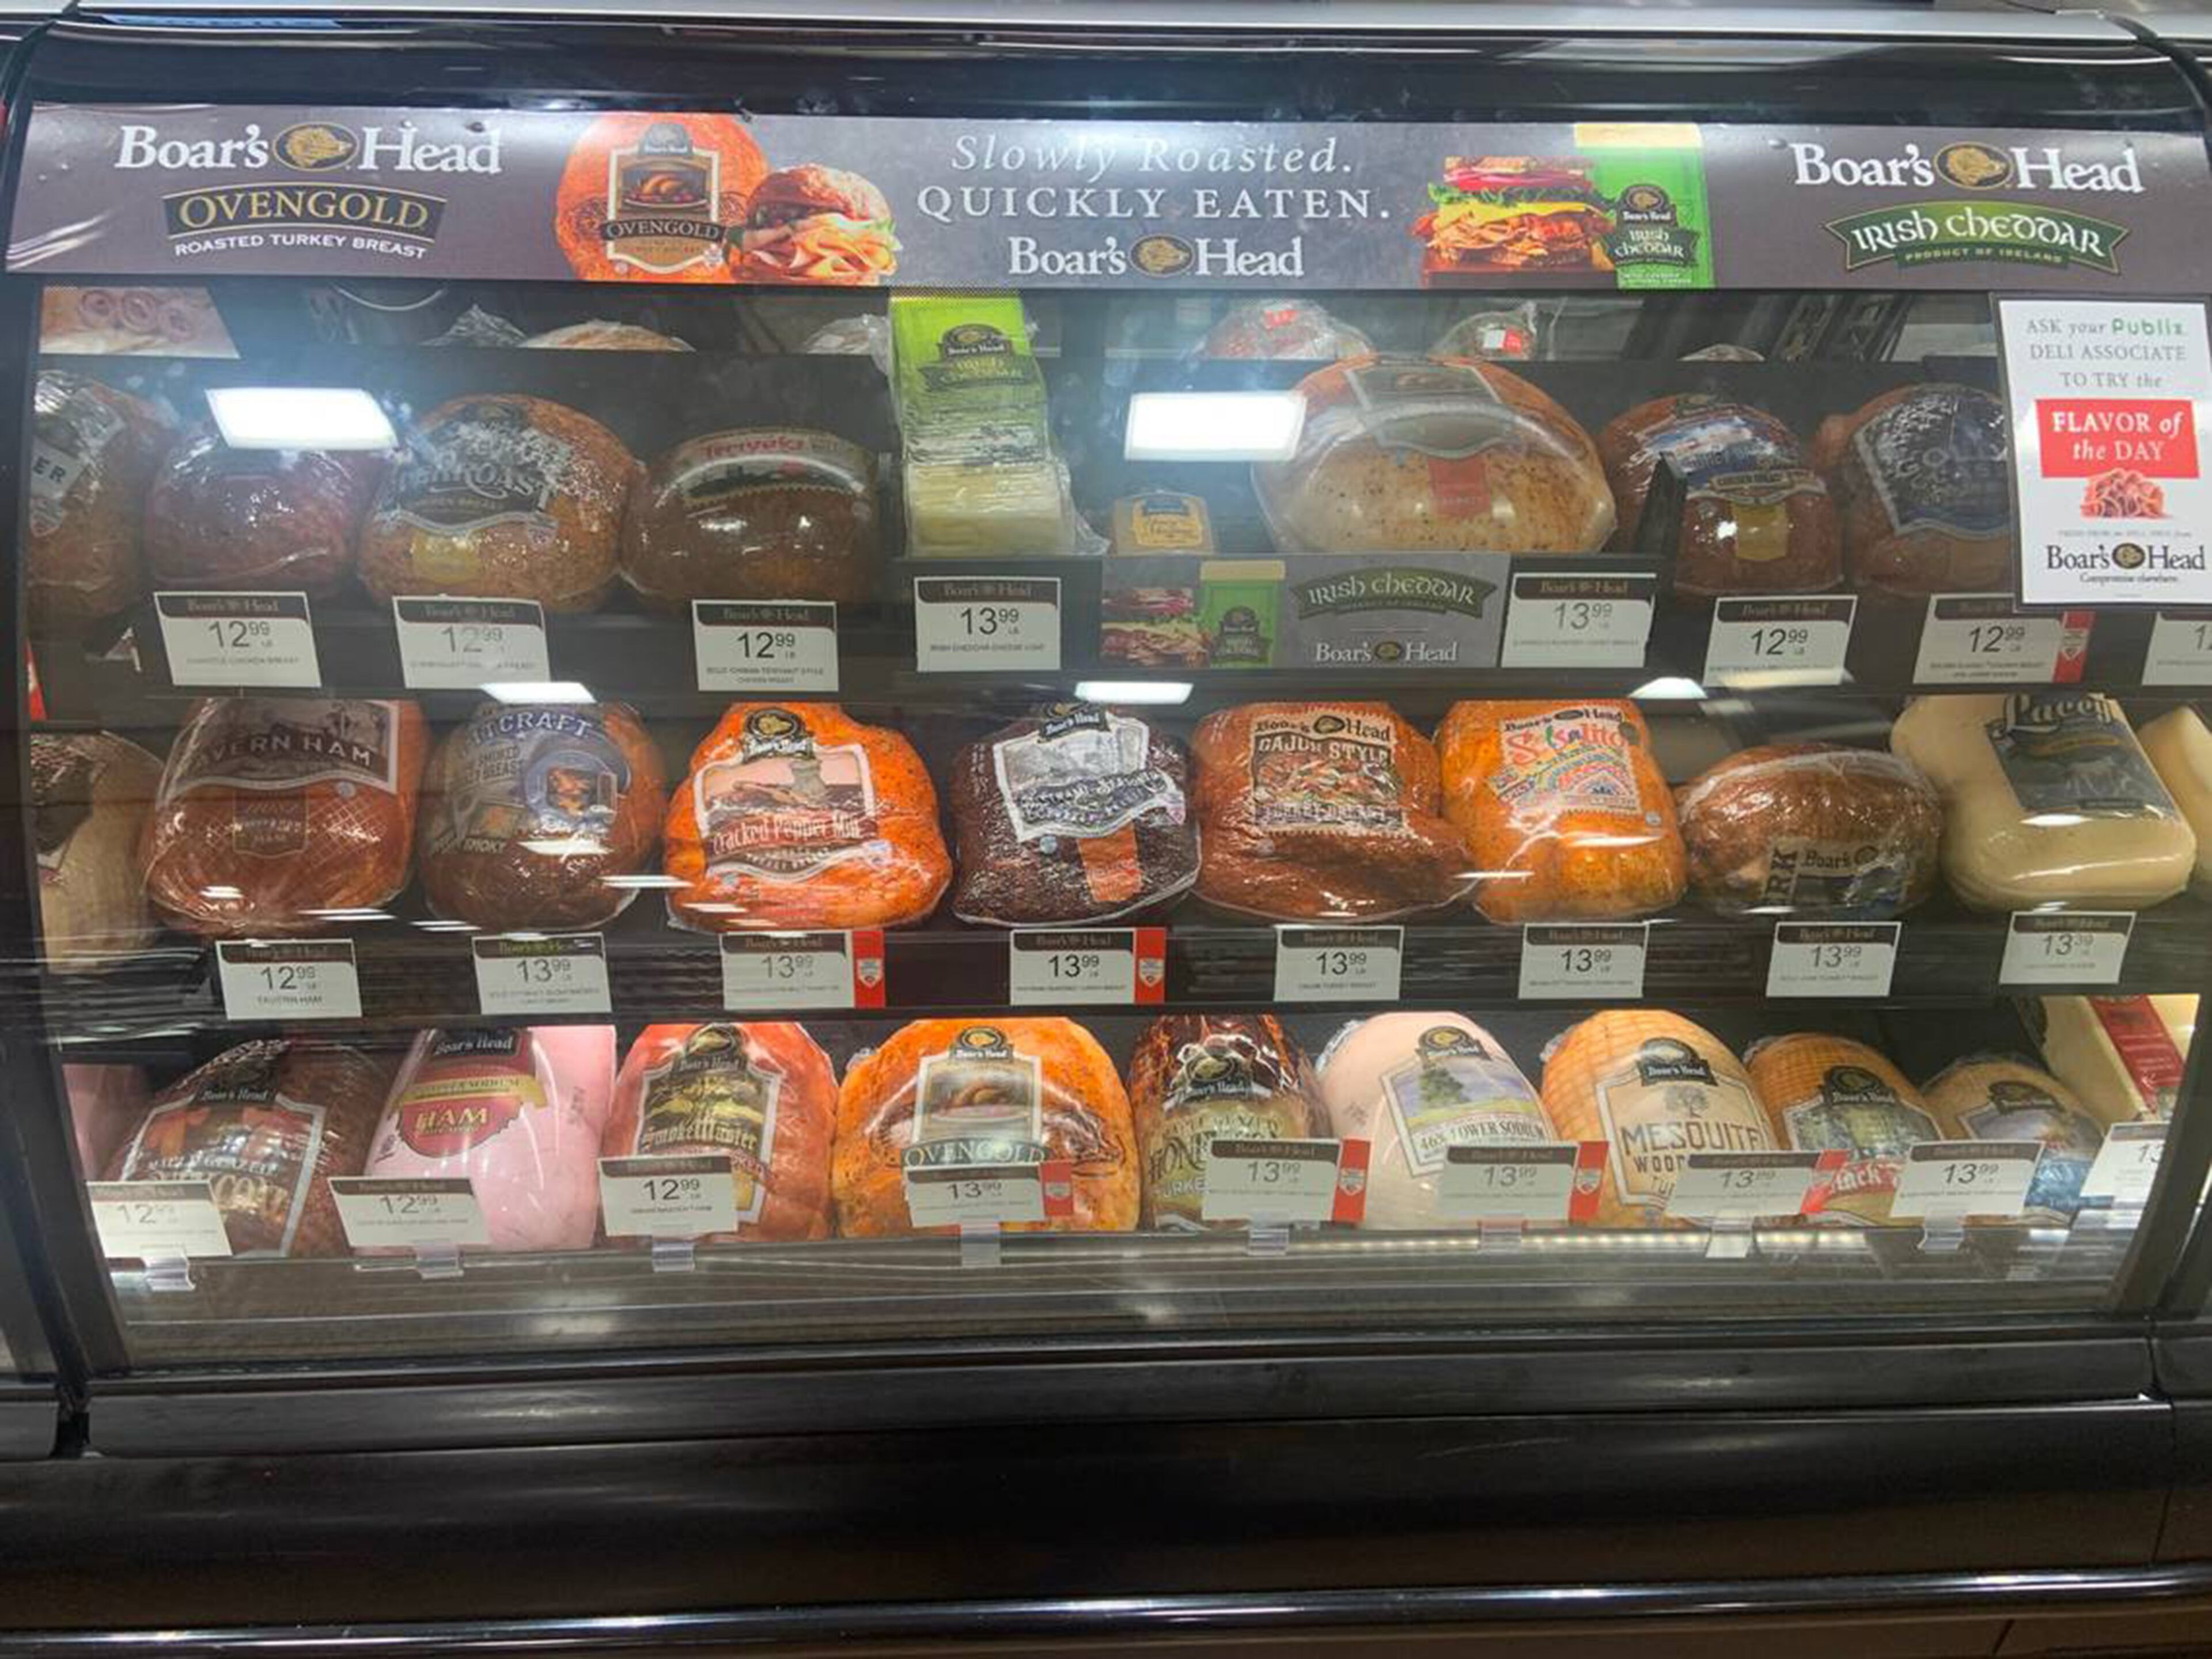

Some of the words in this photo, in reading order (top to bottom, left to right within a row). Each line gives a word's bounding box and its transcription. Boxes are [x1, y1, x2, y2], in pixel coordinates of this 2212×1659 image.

[115, 123, 270, 169] Boar's
[358, 120, 502, 175] Head
[952, 134, 1118, 183] Slowly
[1139, 137, 1351, 172] Roasted.
[1790, 143, 1935, 187] Boar's
[2011, 146, 2146, 194] Head
[179, 189, 429, 229] OVENGOLD
[917, 185, 1168, 224] QUICKLY
[1194, 188, 1390, 218] EATEN.
[605, 219, 719, 240] OVENGOLD
[175, 234, 264, 257] ROASTED
[269, 233, 346, 248] TURKEY
[352, 236, 427, 260] BREAST
[1009, 237, 1126, 275] Boar's
[1195, 236, 1304, 276] Head
[2026, 319, 2062, 334] ASK
[2069, 321, 2107, 337] your
[2111, 317, 2183, 336] Publix
[2030, 344, 2074, 359] DELI
[2081, 344, 2187, 361] ASSOCIATE
[2060, 372, 2088, 387] TO
[2091, 372, 2129, 388] TRY
[2136, 373, 2164, 388] the
[2052, 411, 2152, 433] FLAVOR
[2160, 412, 2184, 438] of
[2073, 439, 2107, 460] the
[2114, 441, 2165, 461] DAY
[2047, 544, 2110, 570] Boar's
[2147, 544, 2206, 570] Head
[960, 607, 1020, 635] 1399
[1555, 602, 1613, 630] 1399
[209, 620, 271, 648] 1299
[441, 626, 503, 653] 1299
[737, 631, 796, 658] 1299
[1751, 628, 1809, 655] 1299
[1969, 625, 2025, 653] 1299
[1315, 642, 1372, 662] Boar's
[1404, 641, 1458, 662] Head
[1346, 718, 1391, 741] Head
[304, 737, 370, 766] HAM
[1258, 734, 1323, 752] CAJUN
[761, 955, 813, 979] 1399
[1048, 953, 1100, 978] 1399
[1316, 952, 1367, 975] 1399
[1560, 948, 1612, 972] 1399
[1811, 945, 1862, 968] 1399
[261, 965, 316, 990] 1299
[516, 958, 571, 983] 1399
[476, 1035, 513, 1050] Head
[415, 1107, 488, 1132] HAM
[1620, 1120, 1762, 1156] MESQUITE
[904, 1141, 1046, 1168] OVENGOLD
[1247, 1161, 1302, 1182] 1399
[1483, 1165, 1538, 1187] 1399
[1943, 1163, 1999, 1184] 1399
[643, 1179, 701, 1201] 1299
[948, 1181, 1002, 1200] 1399
[1153, 1176, 1210, 1198] URKE
[380, 1194, 438, 1215] 1299
